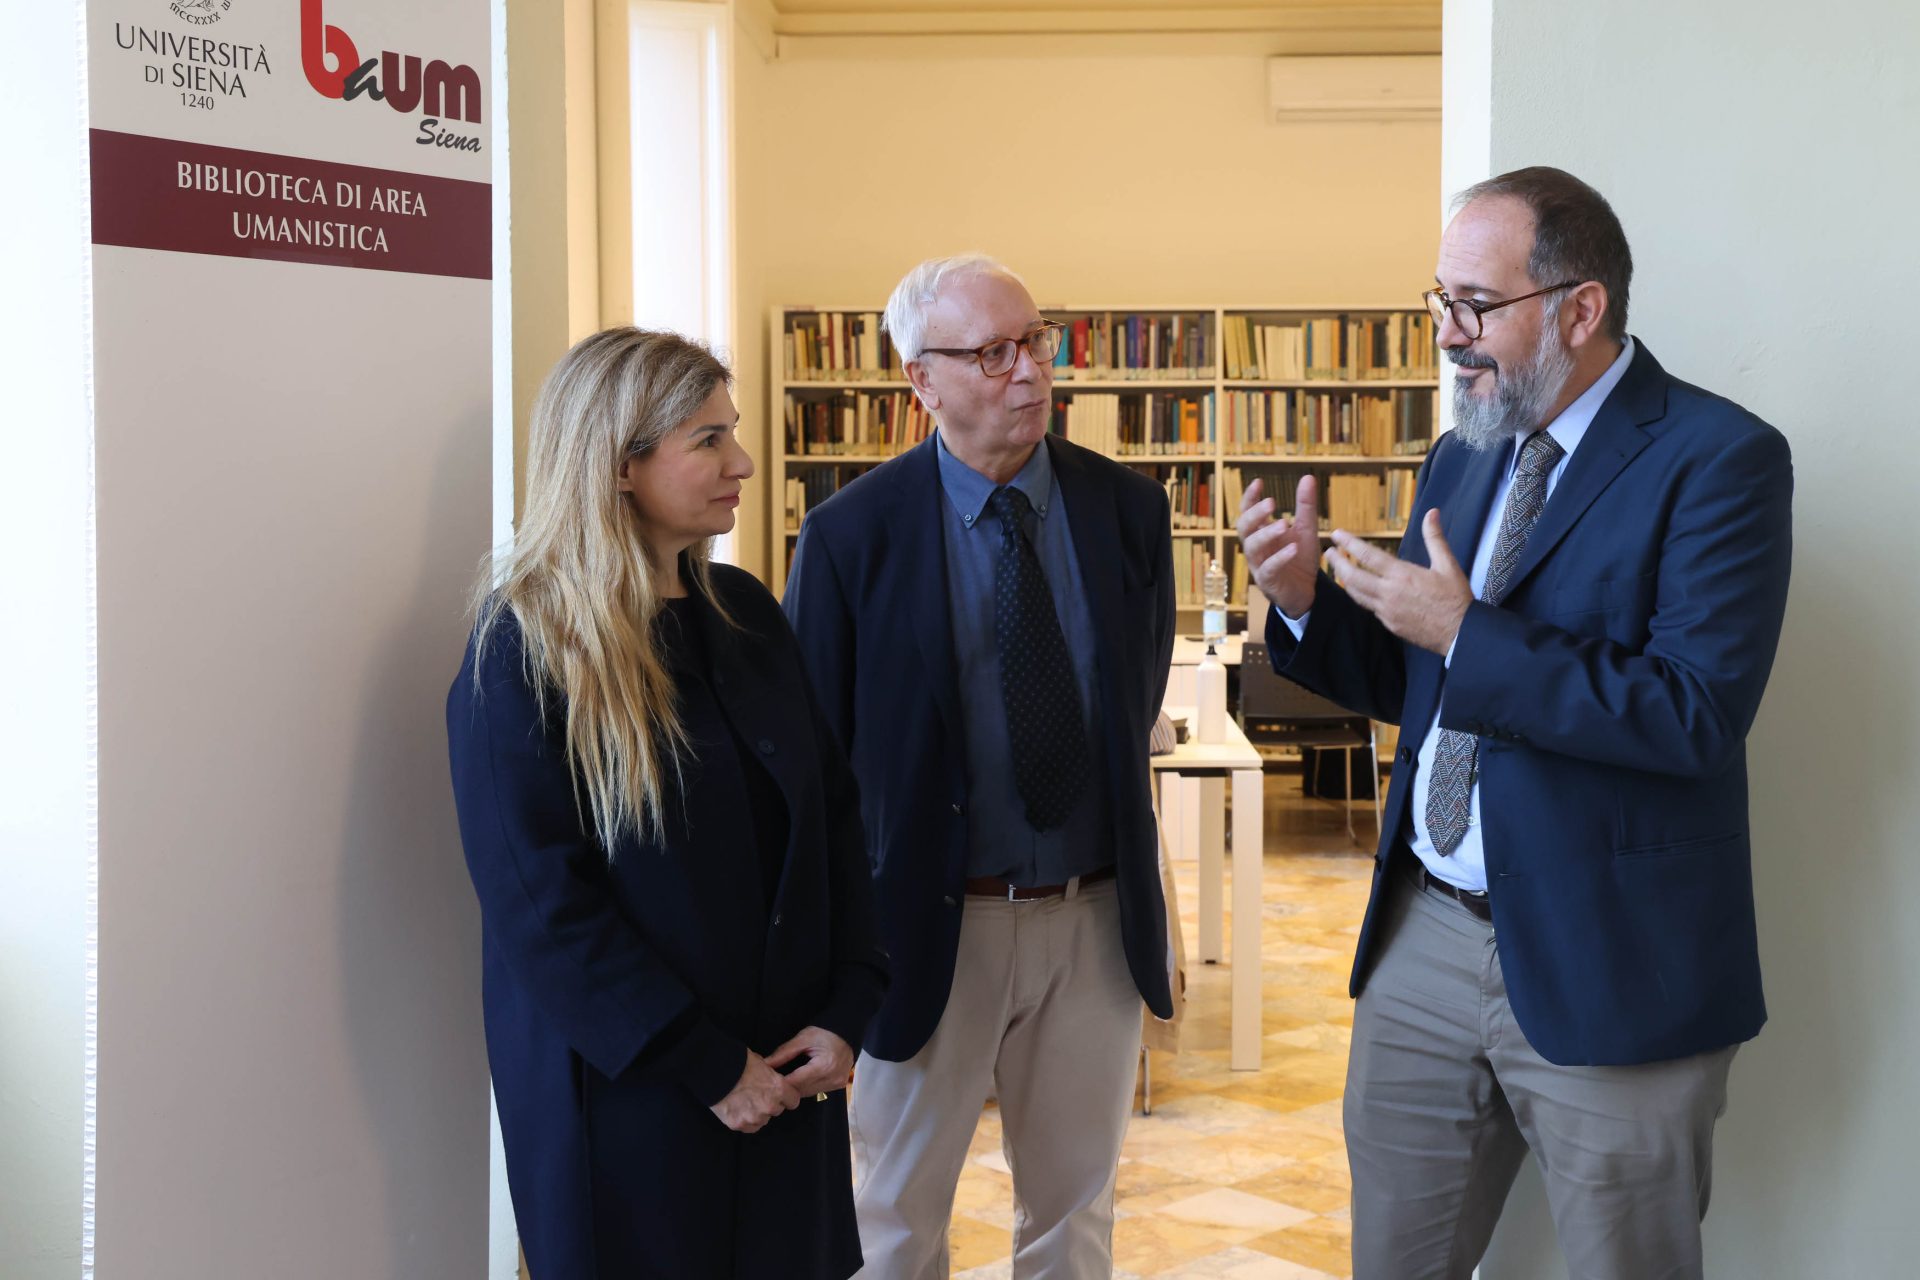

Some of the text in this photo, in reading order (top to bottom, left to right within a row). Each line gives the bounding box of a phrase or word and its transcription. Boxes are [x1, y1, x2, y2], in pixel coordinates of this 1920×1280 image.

[115, 22, 272, 75] UNIVERSITÀ
[145, 62, 247, 99] DI SIENA
[180, 92, 215, 111] 1240
[415, 118, 482, 154] Siena
[177, 161, 428, 217] BIBLIOTECA DI AREA
[232, 211, 390, 253] UMANISTICA
